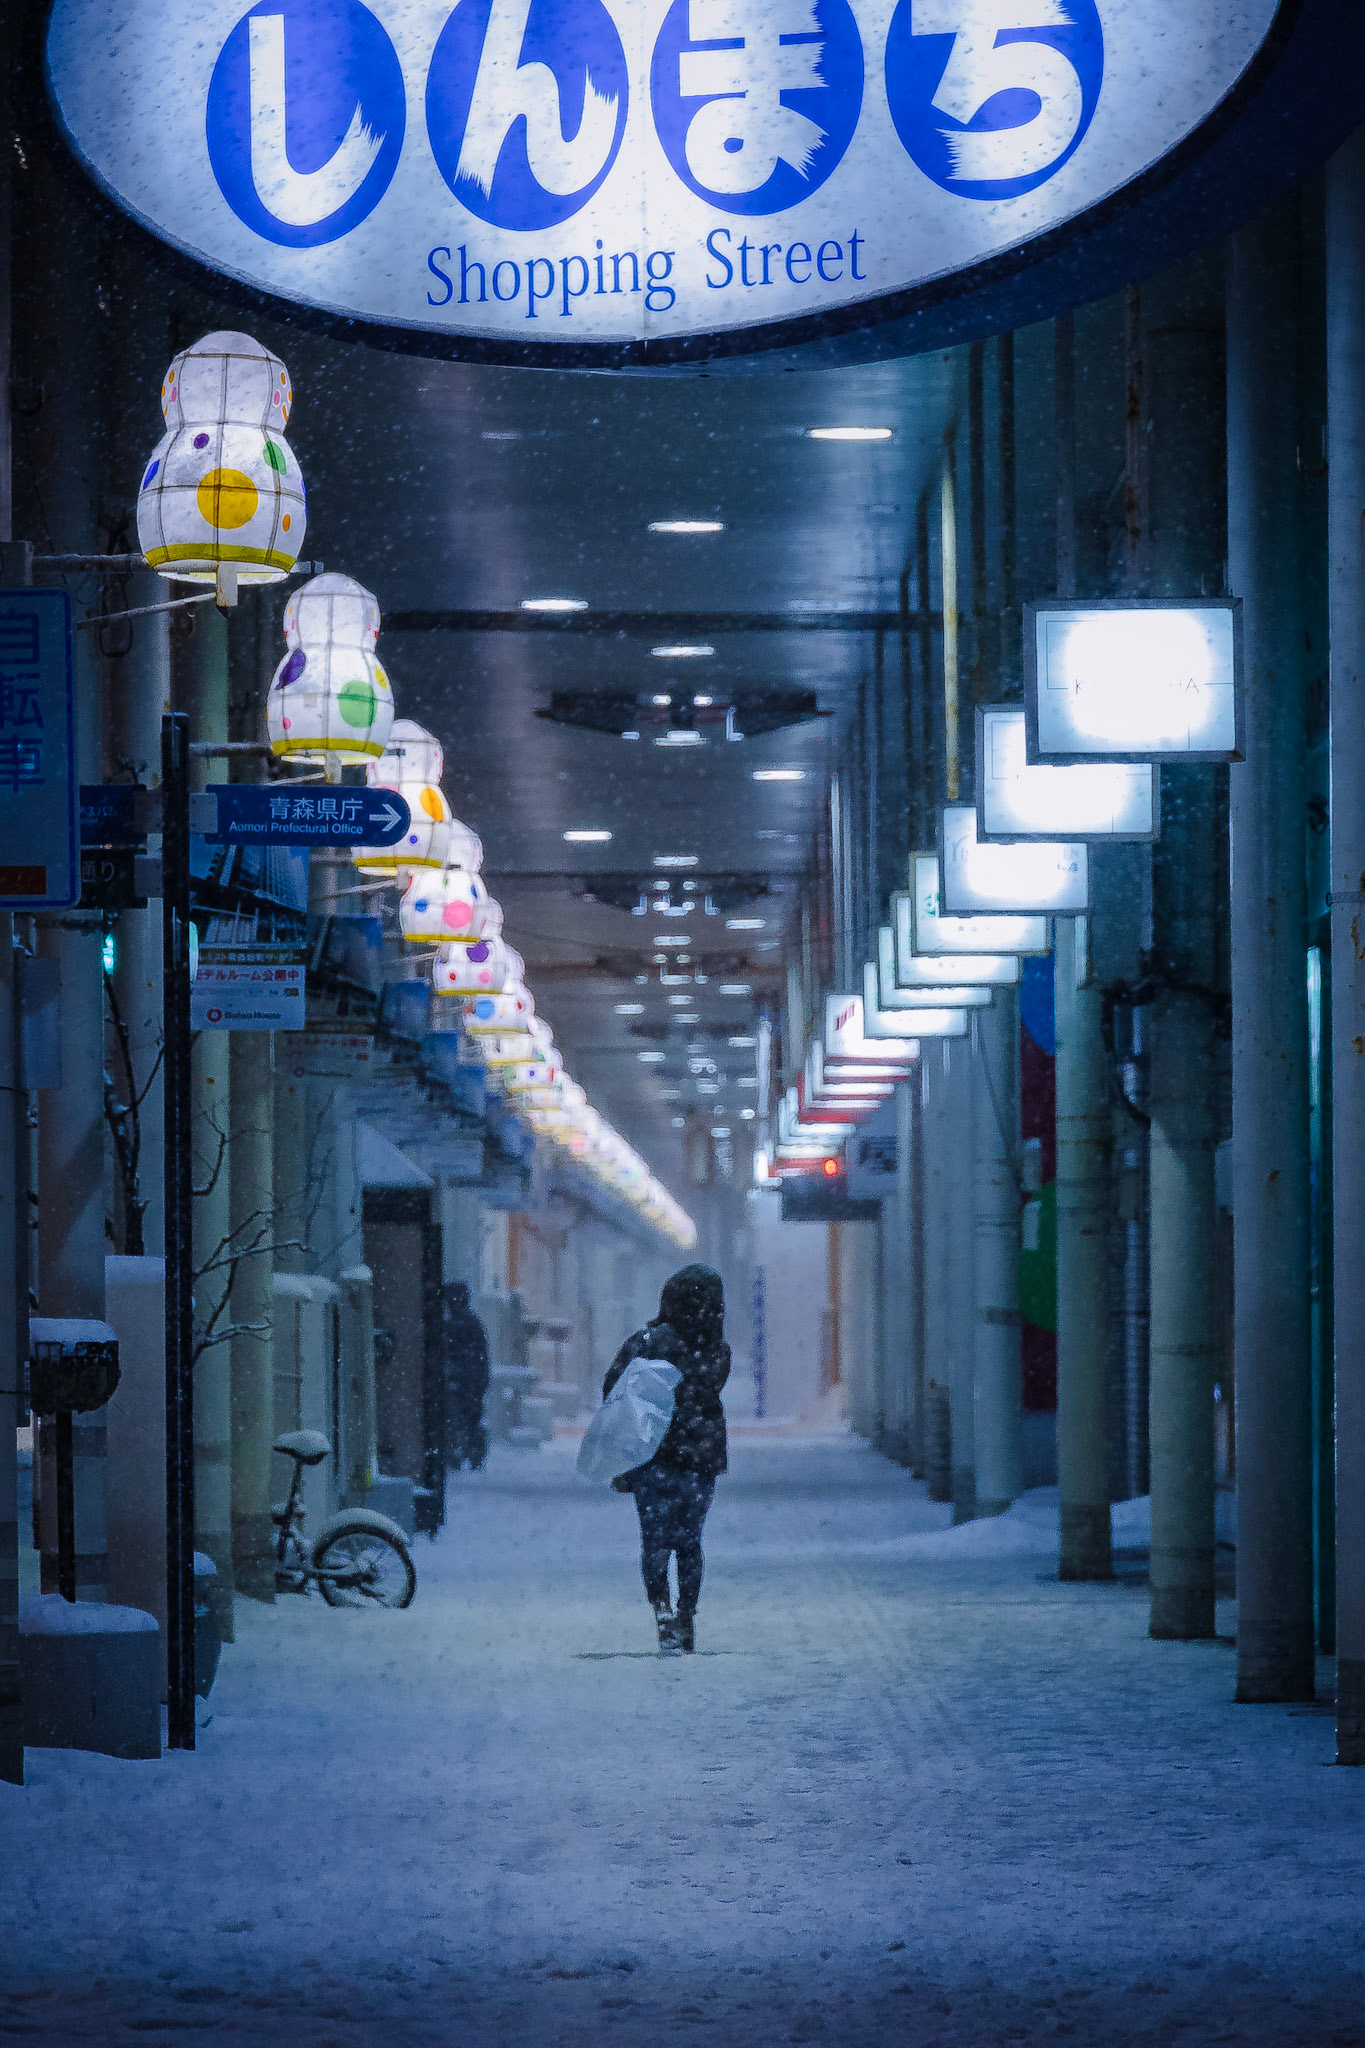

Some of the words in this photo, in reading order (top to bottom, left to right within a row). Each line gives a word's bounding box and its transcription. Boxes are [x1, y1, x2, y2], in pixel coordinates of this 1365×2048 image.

[248, 0, 1084, 227] しんまち
[427, 239, 677, 319] Shopping
[706, 227, 867, 290] Street
[229, 821, 268, 833] Aomori
[271, 822, 329, 834] Prefectural
[331, 822, 364, 835] Office
[269, 797, 364, 821] 青森県庁
